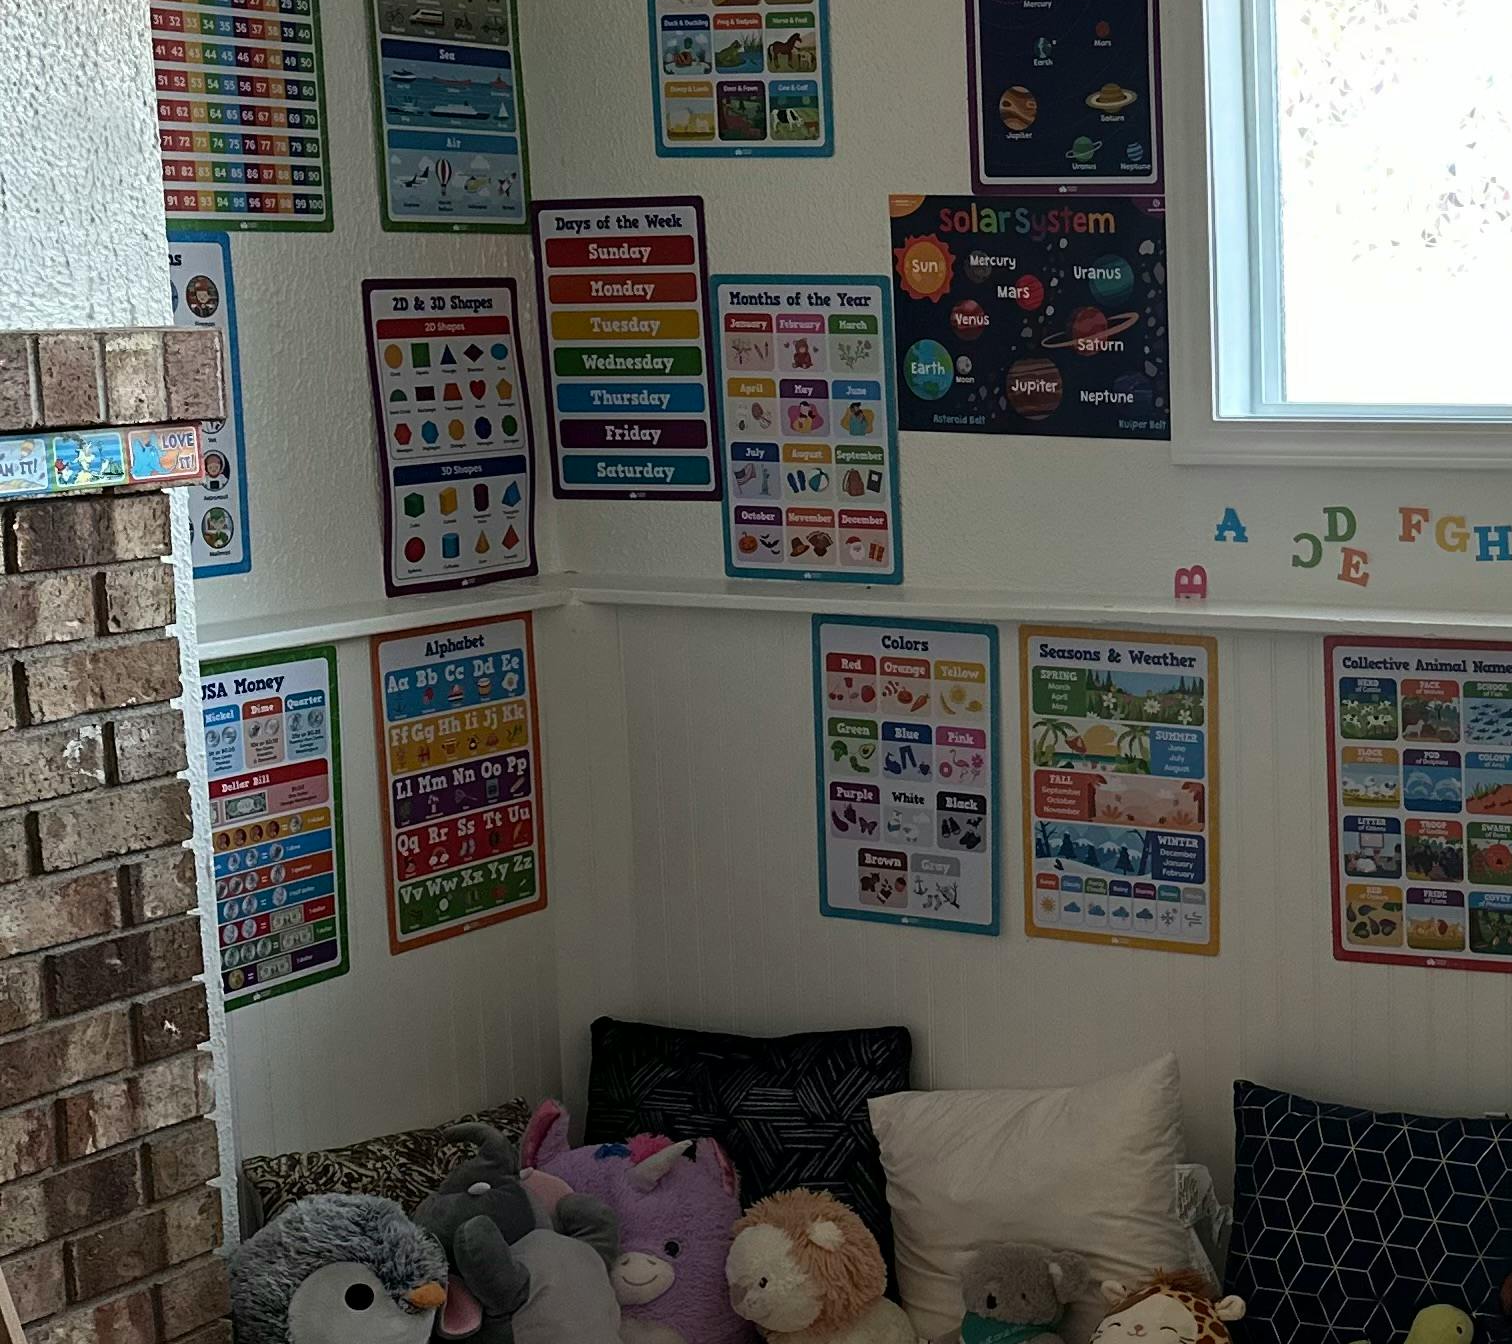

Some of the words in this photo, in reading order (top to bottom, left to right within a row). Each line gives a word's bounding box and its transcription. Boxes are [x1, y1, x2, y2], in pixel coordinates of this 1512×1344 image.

[1023, 0, 1052, 9] Mercury
[439, 49, 456, 62] Sea
[445, 137, 462, 149] Air
[555, 217, 590, 235] Days
[596, 216, 610, 230] of
[615, 215, 639, 229] the
[644, 214, 682, 228] Week
[588, 243, 652, 264] Sunday
[911, 259, 938, 273] Sun
[969, 255, 1016, 270] Mercury
[1073, 266, 1121, 279] Uranus
[590, 280, 656, 300] Monday
[997, 285, 1030, 299] Mars
[392, 297, 408, 311] 2D
[413, 297, 425, 310] &
[430, 297, 446, 310] 3D
[450, 296, 493, 313] Shapes
[729, 292, 781, 306] Months
[786, 292, 802, 306] of
[806, 292, 832, 306] the
[837, 293, 872, 307] Year
[730, 319, 768, 331] January
[779, 319, 820, 331] February
[839, 320, 868, 330] March
[955, 313, 990, 326] Venus
[590, 317, 661, 337] Tuesday
[1077, 337, 1124, 352] Saturn
[582, 353, 675, 373] Wednesday
[911, 361, 945, 375] Earth
[739, 383, 764, 395] April
[794, 385, 813, 396] May
[845, 385, 867, 395] June
[1010, 379, 1058, 395] Jupiter
[590, 390, 670, 409] Thursday
[1079, 390, 1134, 405] Neptune
[162, 432, 195, 449] LOVE
[604, 425, 662, 445] Friday
[745, 447, 765, 459] July
[791, 448, 823, 460] August
[836, 450, 883, 462] September
[178, 453, 195, 470] IT!
[441, 467, 452, 476] 3D
[453, 465, 483, 475] Shapes
[596, 462, 675, 482] Saturday
[741, 511, 775, 521] October
[788, 512, 833, 523] November
[841, 515, 885, 525] December
[1214, 507, 1248, 542] A
[1322, 505, 1357, 542] D
[1397, 506, 1430, 542] F
[1433, 515, 1470, 552] G
[1336, 546, 1370, 587] E
[424, 634, 485, 657] Alphabet
[881, 636, 929, 651] Colors
[1039, 643, 1101, 661] Seasons
[1107, 649, 1122, 663] &
[1128, 650, 1196, 668] Weather
[841, 658, 862, 670] Red
[883, 661, 926, 676] Orange
[1342, 656, 1410, 671] Collective
[1415, 658, 1469, 673] Animal
[387, 675, 410, 693] Aa
[415, 669, 438, 688] Bb
[444, 664, 465, 681] Cc
[472, 659, 494, 677] Dd
[501, 654, 520, 672] Ee
[940, 665, 979, 679] Yellow
[1040, 670, 1078, 681] SPRING
[234, 675, 285, 697] Money
[250, 702, 275, 715] Dime
[286, 694, 323, 712] Quarter
[836, 723, 870, 735] Green
[894, 727, 919, 740] Blue
[947, 731, 975, 744] Pink
[1155, 730, 1198, 743] SUMMER
[417, 773, 448, 793] Mm
[481, 760, 502, 778] Oo
[1049, 775, 1073, 785] FALL
[836, 787, 874, 801] Purple
[891, 791, 925, 805] White
[945, 796, 979, 810] Black
[1157, 835, 1200, 848] WINTER
[864, 853, 902, 867] Brown
